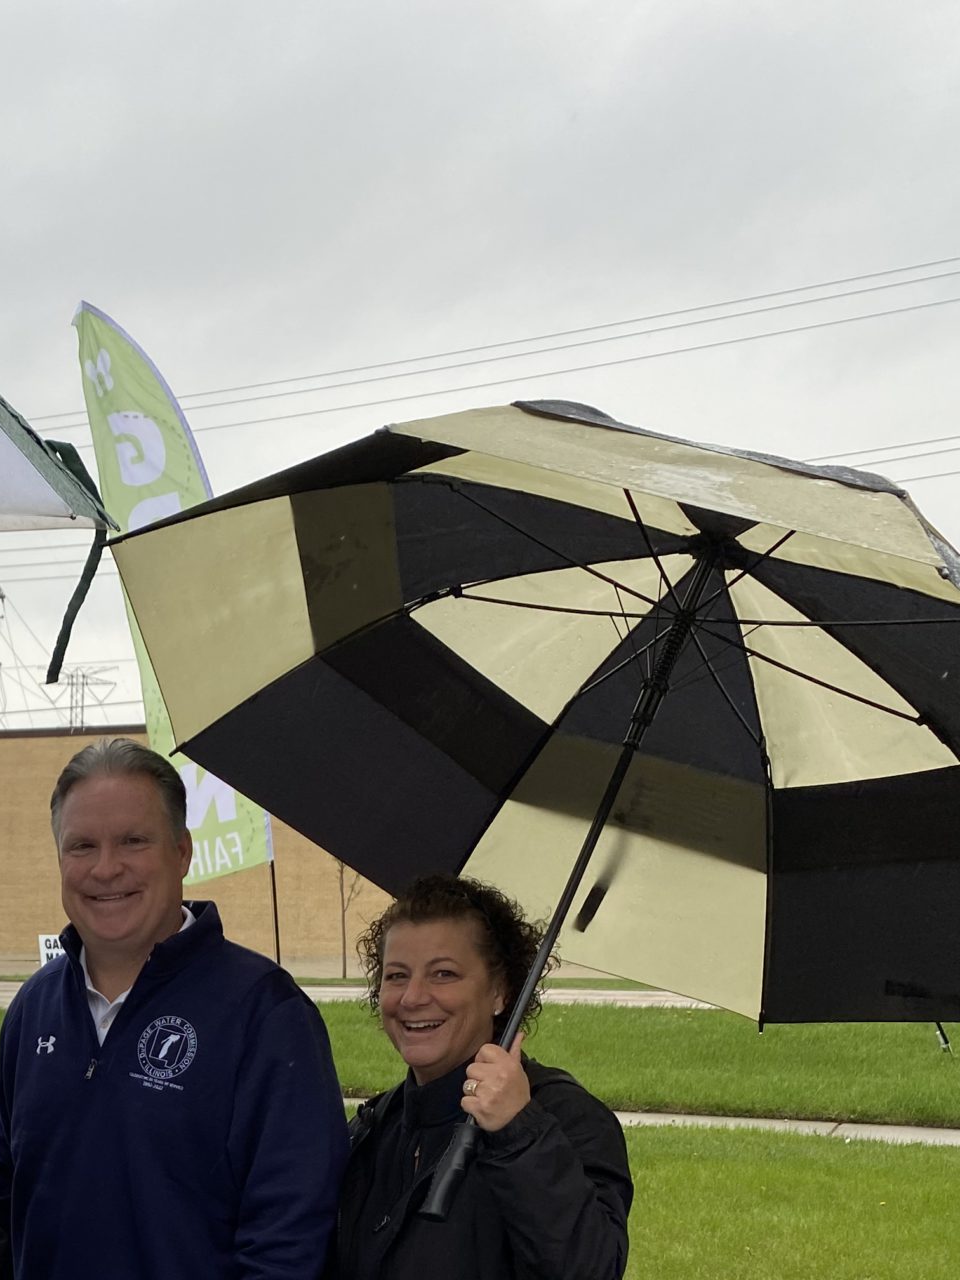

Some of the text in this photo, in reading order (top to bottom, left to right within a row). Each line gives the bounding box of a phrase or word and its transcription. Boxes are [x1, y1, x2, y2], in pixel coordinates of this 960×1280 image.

[44, 938, 64, 950] GA
[154, 1017, 181, 1027] WATER
[179, 1024, 198, 1070] COMMISSION
[144, 1063, 173, 1078] ILLINOIS
